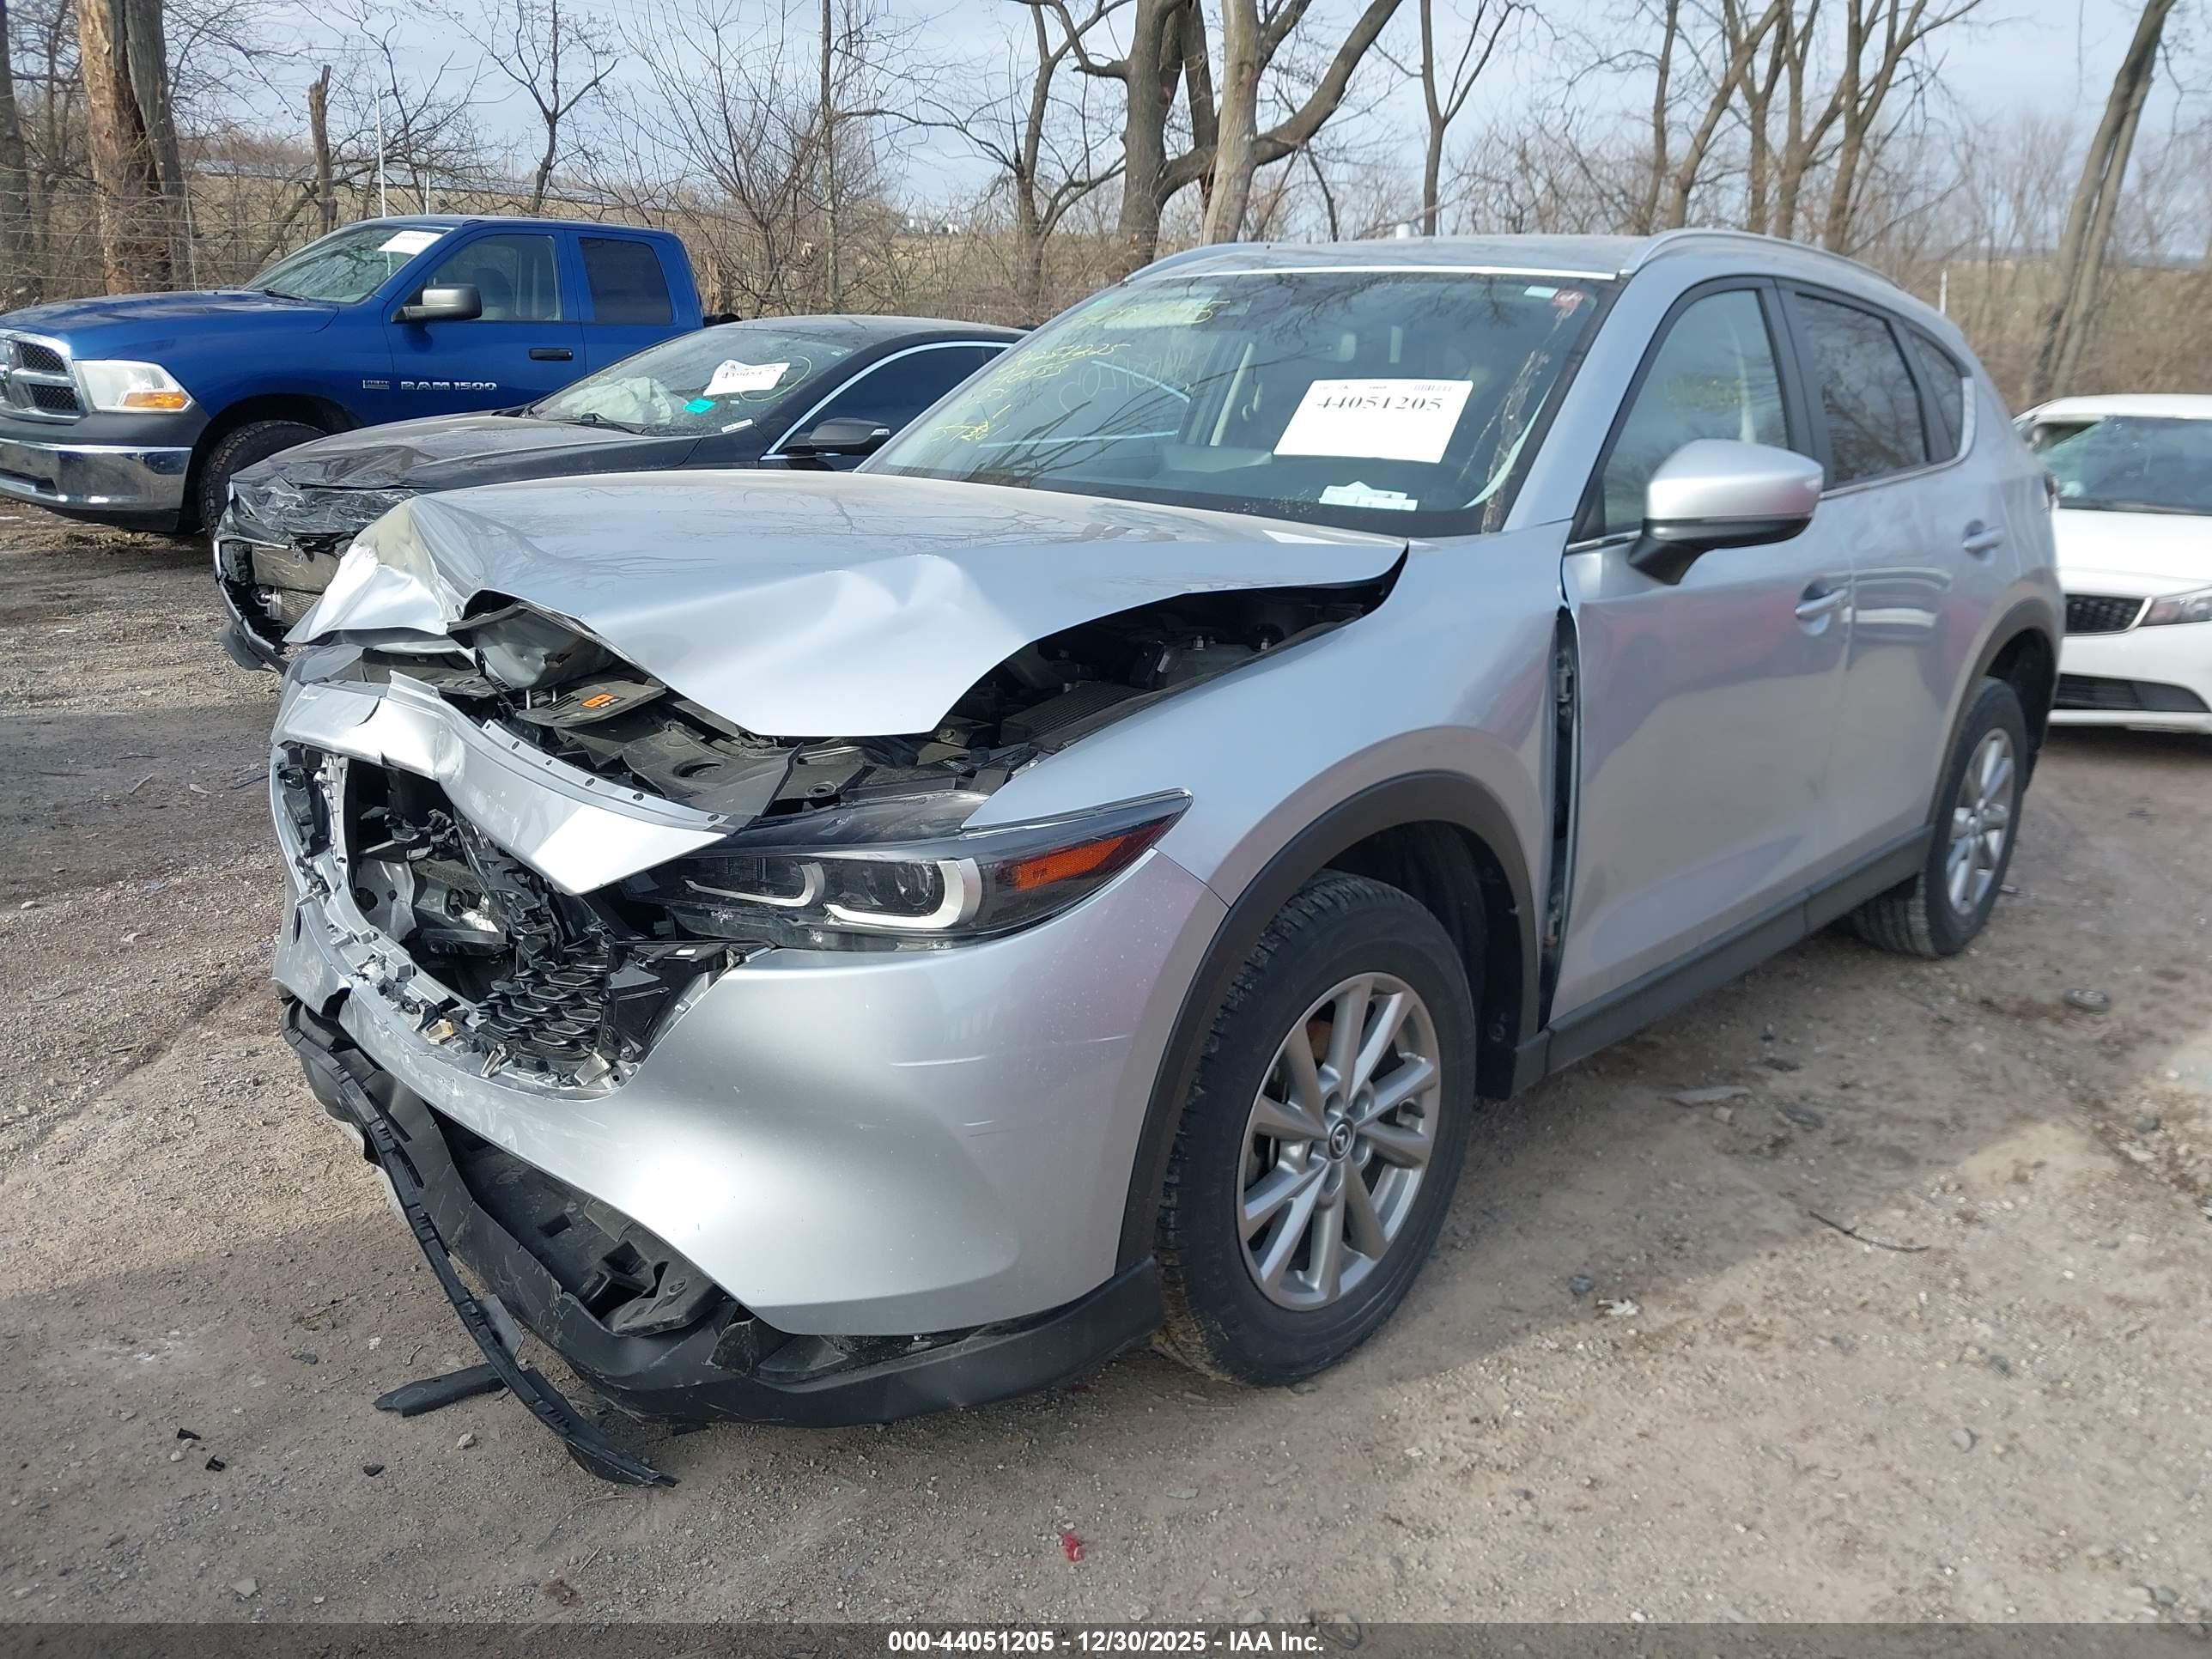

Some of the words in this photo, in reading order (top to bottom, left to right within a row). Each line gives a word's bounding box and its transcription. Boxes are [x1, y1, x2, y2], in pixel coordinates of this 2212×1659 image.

[400, 380, 451, 391] RAM
[453, 381, 498, 392] 1500
[1316, 395, 1444, 411] 44051205
